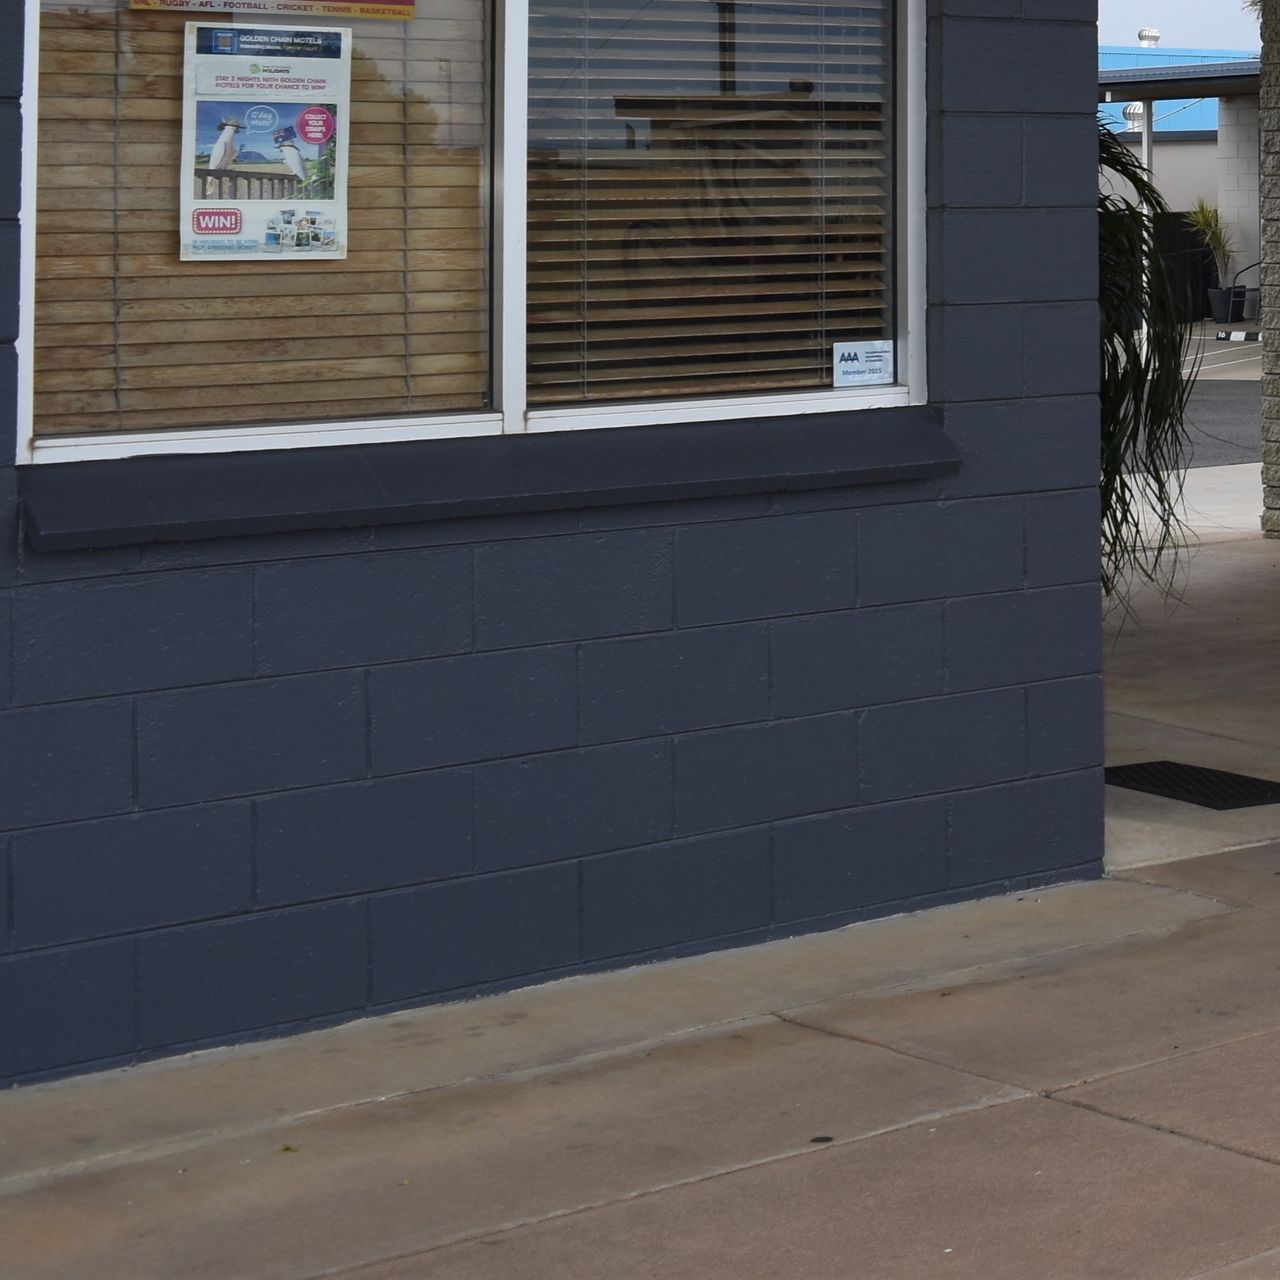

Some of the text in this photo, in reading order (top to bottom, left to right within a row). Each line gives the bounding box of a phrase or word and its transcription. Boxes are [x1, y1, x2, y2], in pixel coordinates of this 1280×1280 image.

[223, 1, 268, 10] FOOTBALL
[276, 3, 314, 12] CRICKET
[322, 5, 352, 13] TENNIS
[359, 7, 411, 16] BASKETBALL
[199, 215, 236, 228] WIN!
[839, 352, 860, 363] AAA
